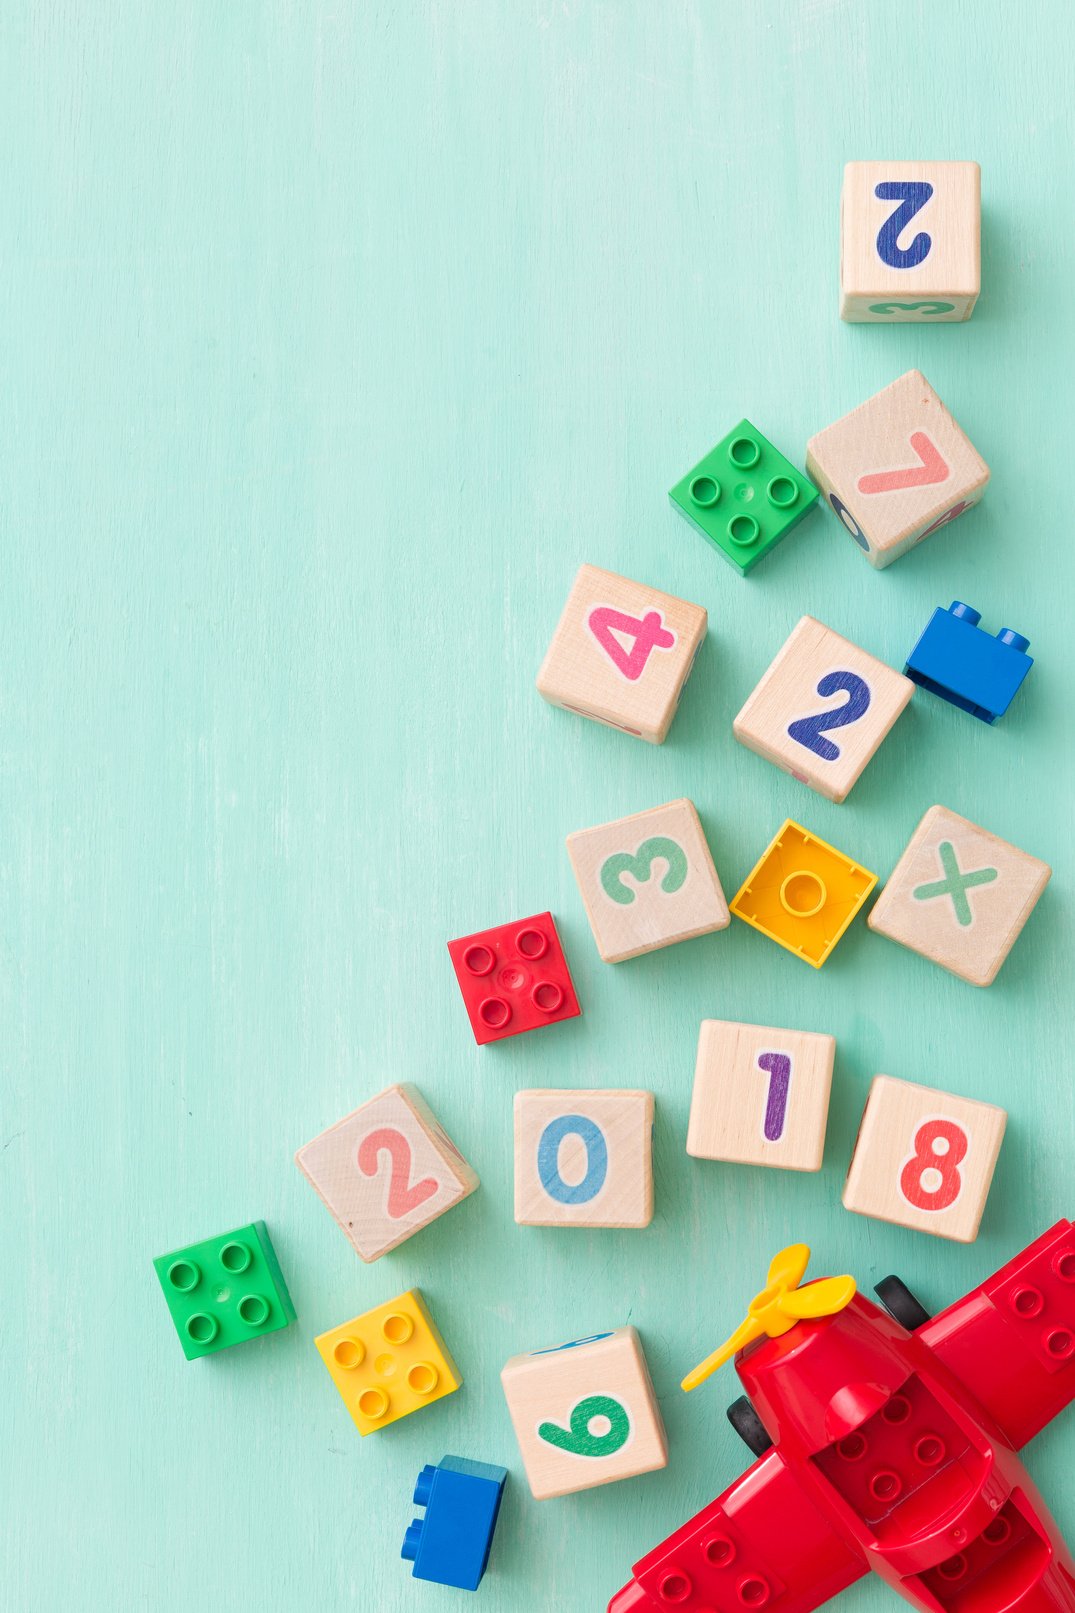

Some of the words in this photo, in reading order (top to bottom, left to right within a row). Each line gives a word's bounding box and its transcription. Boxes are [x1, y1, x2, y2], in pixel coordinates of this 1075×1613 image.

[874, 181, 934, 270] 2
[868, 301, 955, 316] 3
[857, 431, 950, 495] 7
[588, 606, 675, 681] 4
[787, 670, 871, 762] 2
[600, 836, 689, 905] 3
[757, 1052, 791, 1142] 1
[357, 1126, 438, 1218] 2
[537, 1114, 609, 1205] 0
[900, 1119, 968, 1211] 8
